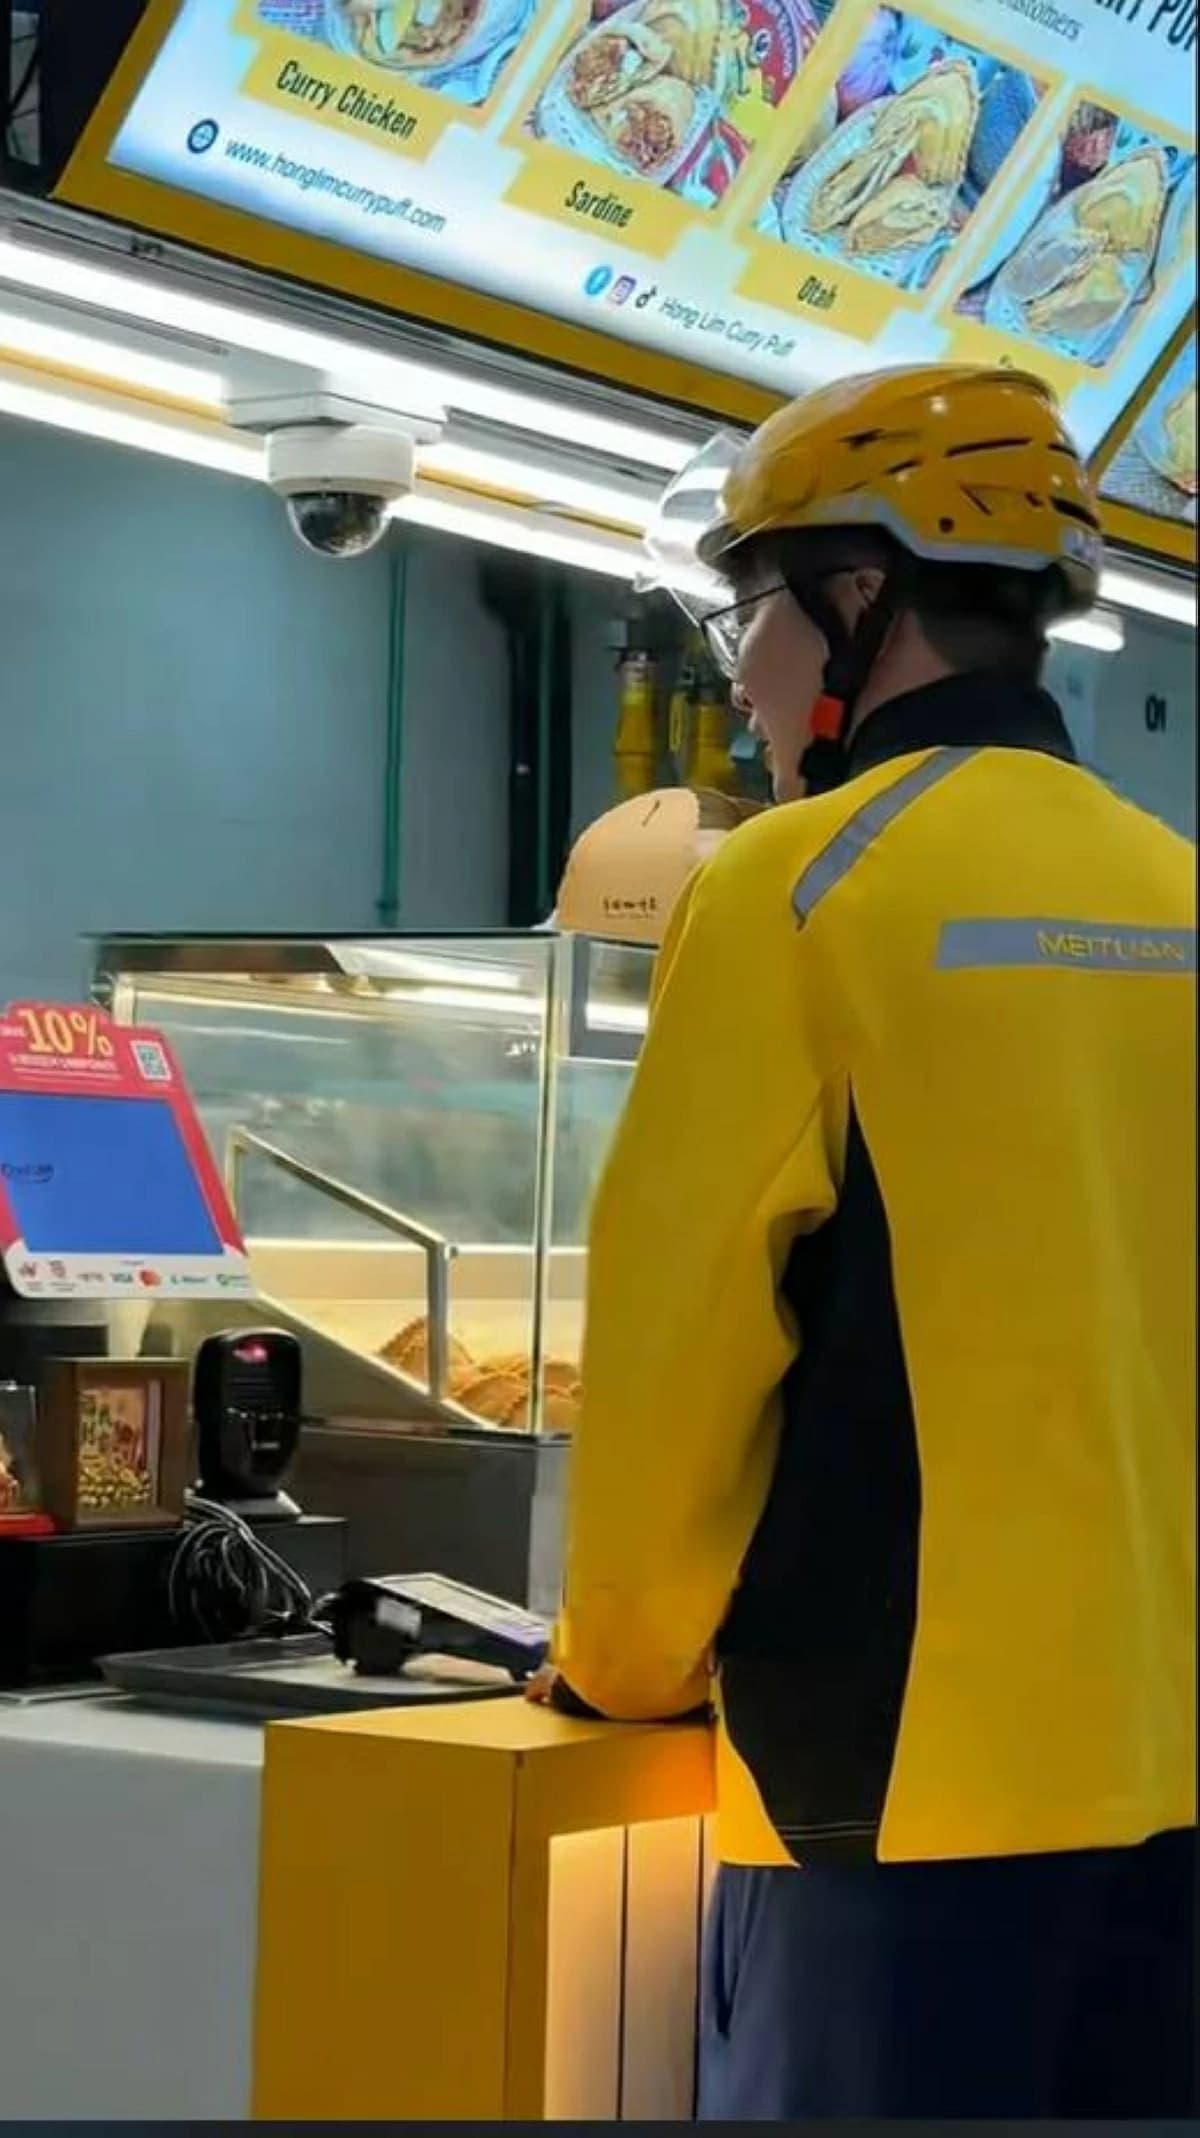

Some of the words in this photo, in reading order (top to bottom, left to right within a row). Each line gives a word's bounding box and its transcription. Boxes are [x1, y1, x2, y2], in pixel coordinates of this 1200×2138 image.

[277, 60, 337, 110] Curry
[338, 84, 418, 139] Chicken
[225, 139, 448, 233] www.honglimcurrypuff.com
[565, 180, 633, 227] Sardine
[797, 275, 837, 310] Otah
[659, 297, 700, 329] Hong
[699, 311, 726, 332] Lim
[727, 320, 764, 352] Curry
[763, 334, 795, 356] Puff
[1035, 930, 1185, 961] MEITUAN
[17, 1008, 115, 1057] 10%
